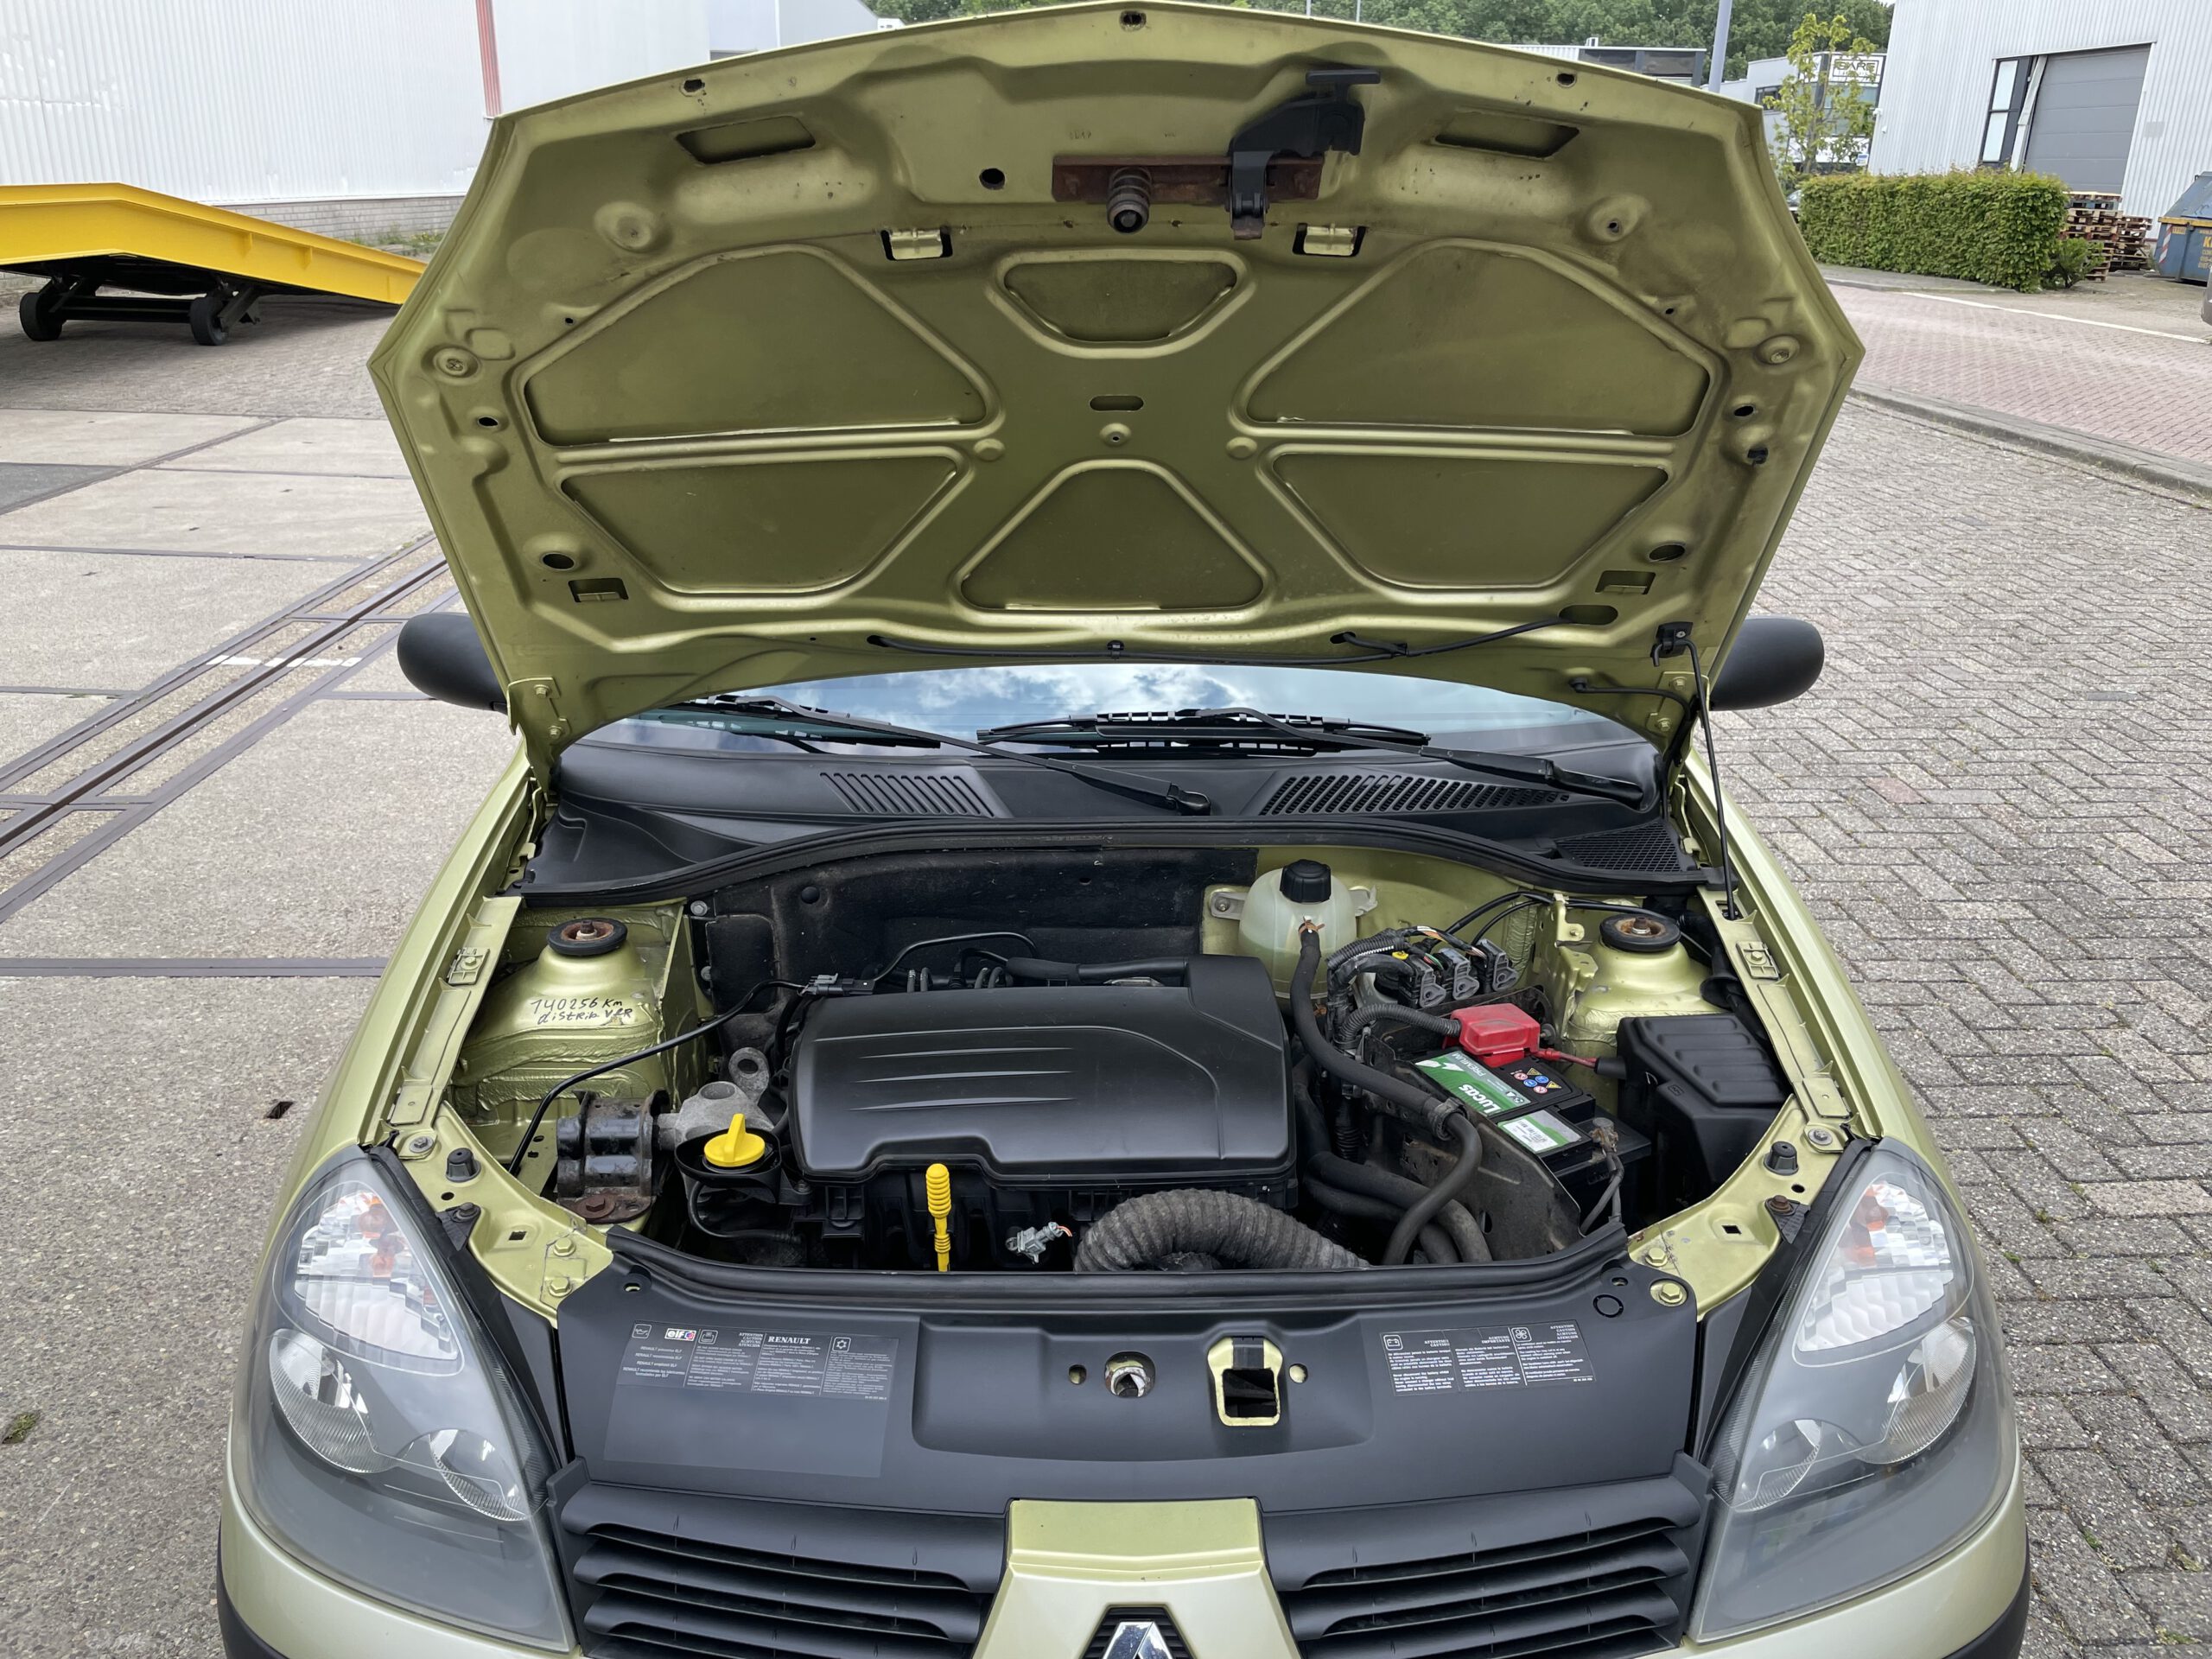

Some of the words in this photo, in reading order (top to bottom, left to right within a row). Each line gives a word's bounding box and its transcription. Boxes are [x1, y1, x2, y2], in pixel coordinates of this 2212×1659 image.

[531, 997, 598, 1014] 140256
[1452, 1052, 1486, 1077] PREMIUM
[767, 1336, 811, 1344] RENAULT
